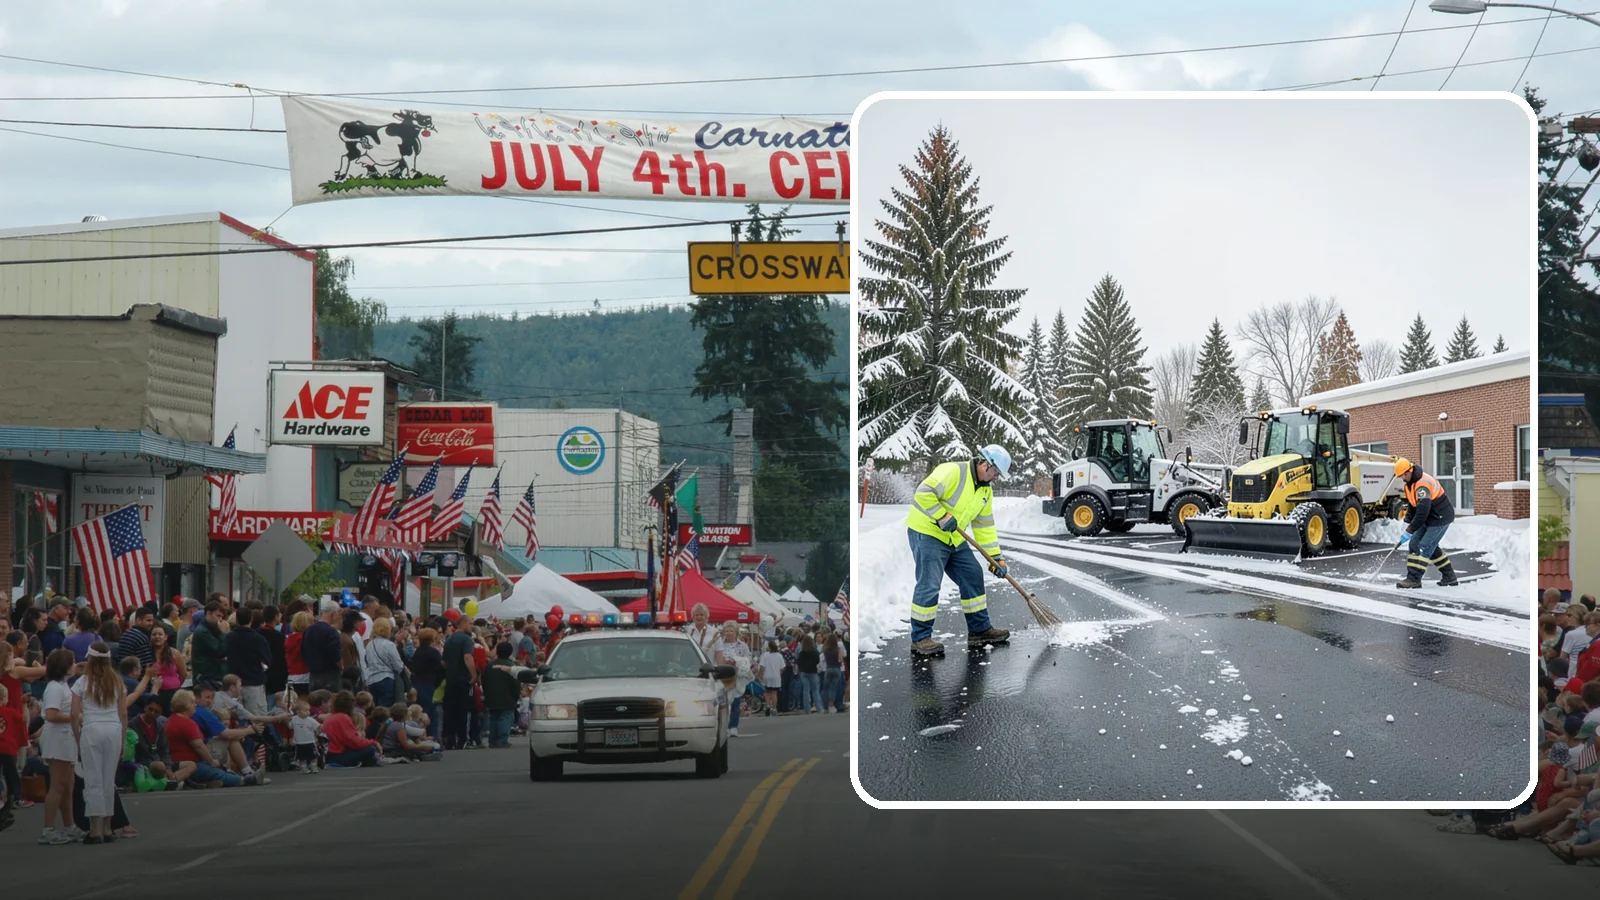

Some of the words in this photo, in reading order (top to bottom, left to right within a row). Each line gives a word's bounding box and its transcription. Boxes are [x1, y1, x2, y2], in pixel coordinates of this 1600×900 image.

[481, 141, 605, 192] JULY
[632, 150, 747, 198] 4th.
[696, 254, 850, 280] CROSSWA
[282, 379, 374, 420] ACE
[405, 408, 453, 422] CEDAR
[461, 409, 486, 422] LOG
[283, 420, 371, 437] Hardware
[353, 467, 385, 481] Simpl
[95, 485, 125, 494] Vincent
[126, 486, 136, 494] de
[137, 486, 155, 495] Paul
[688, 526, 742, 535] CRNATION
[699, 535, 730, 544] GLASS
